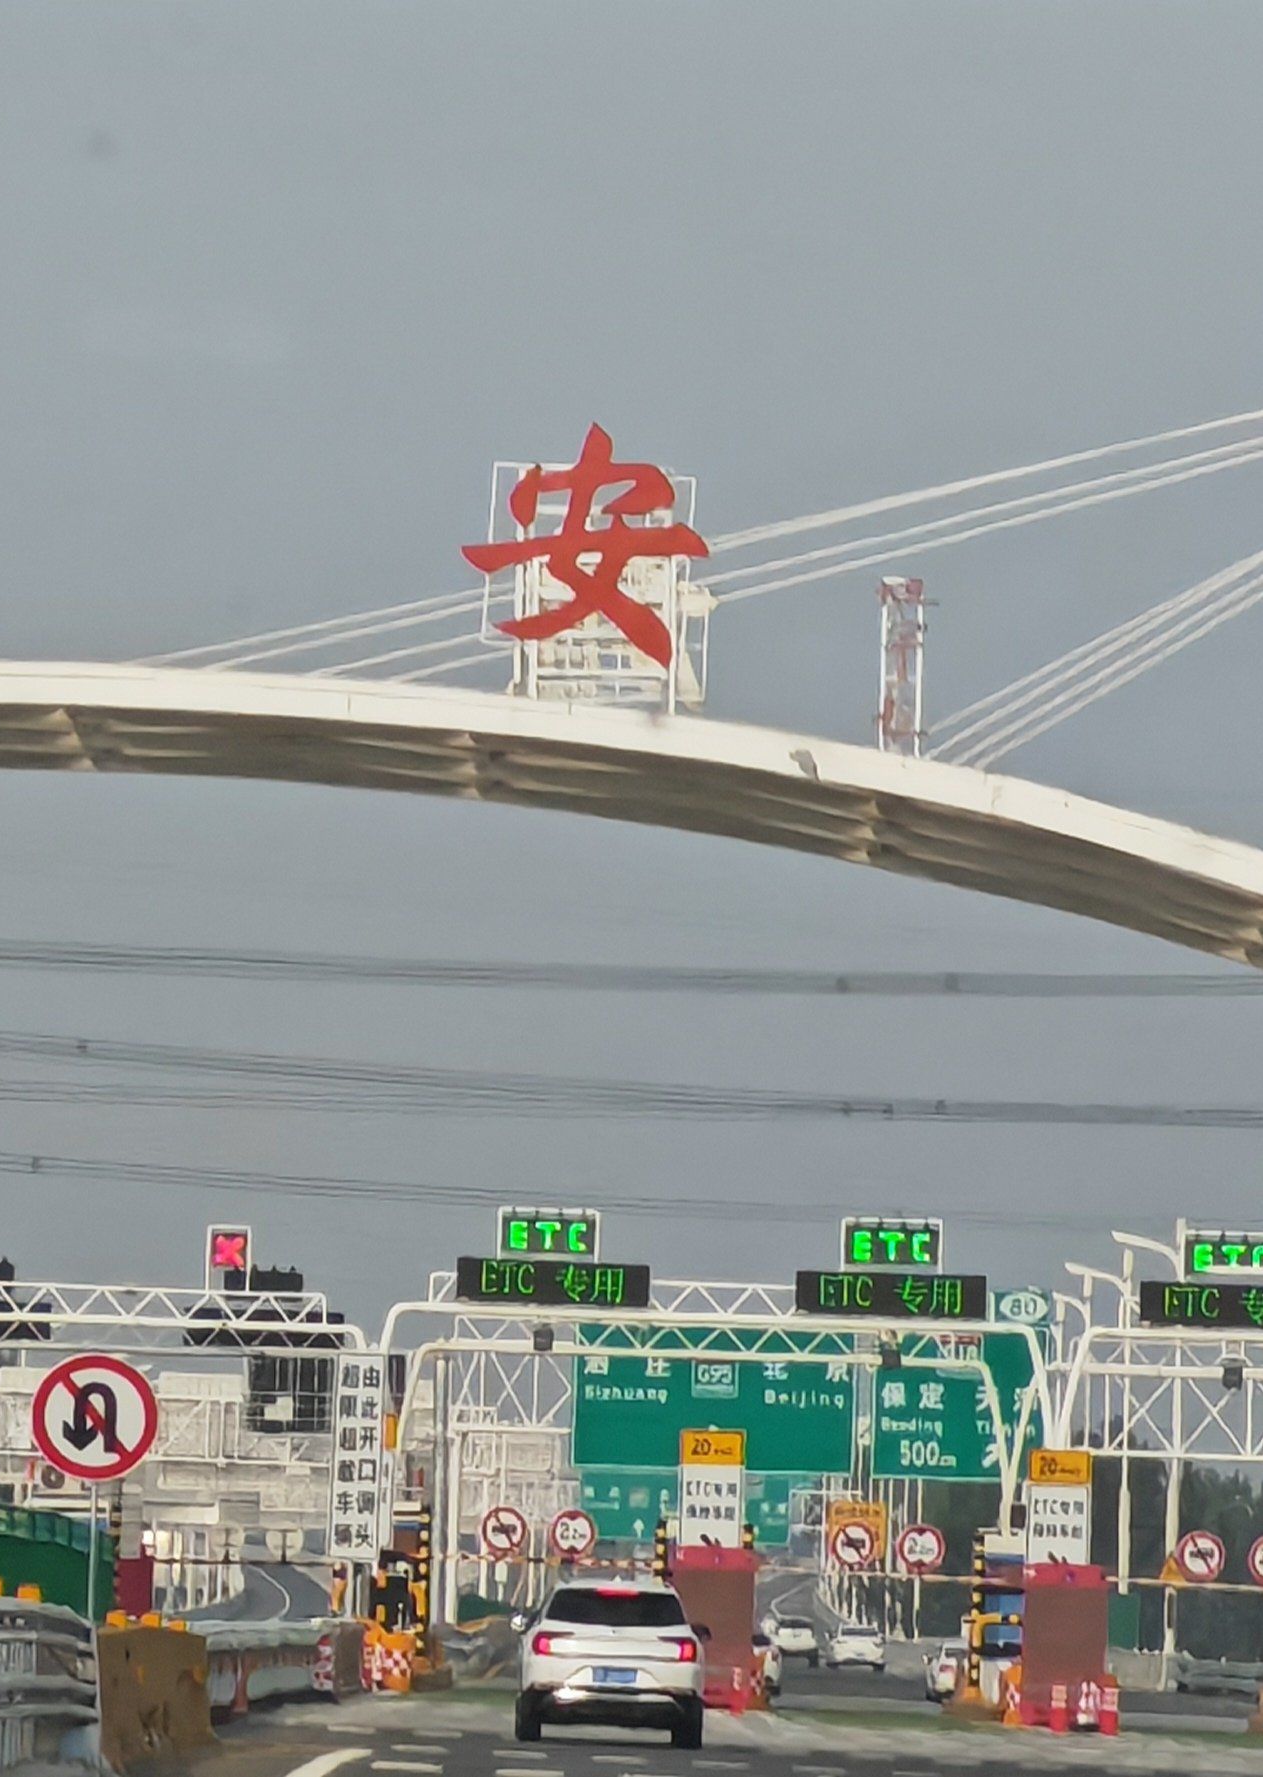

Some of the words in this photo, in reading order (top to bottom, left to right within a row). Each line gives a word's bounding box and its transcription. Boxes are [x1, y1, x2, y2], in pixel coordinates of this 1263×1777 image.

[460, 421, 710, 670] 安
[509, 1221, 587, 1252] ETC
[853, 1231, 931, 1262] ETC
[481, 1260, 535, 1294] ETC
[555, 1263, 624, 1303] 专用
[820, 1274, 873, 1308] ETC
[893, 1276, 962, 1315] 专用
[764, 1389, 844, 1409] Beijing
[881, 1382, 945, 1410] 保定
[881, 1416, 943, 1438] Baoding
